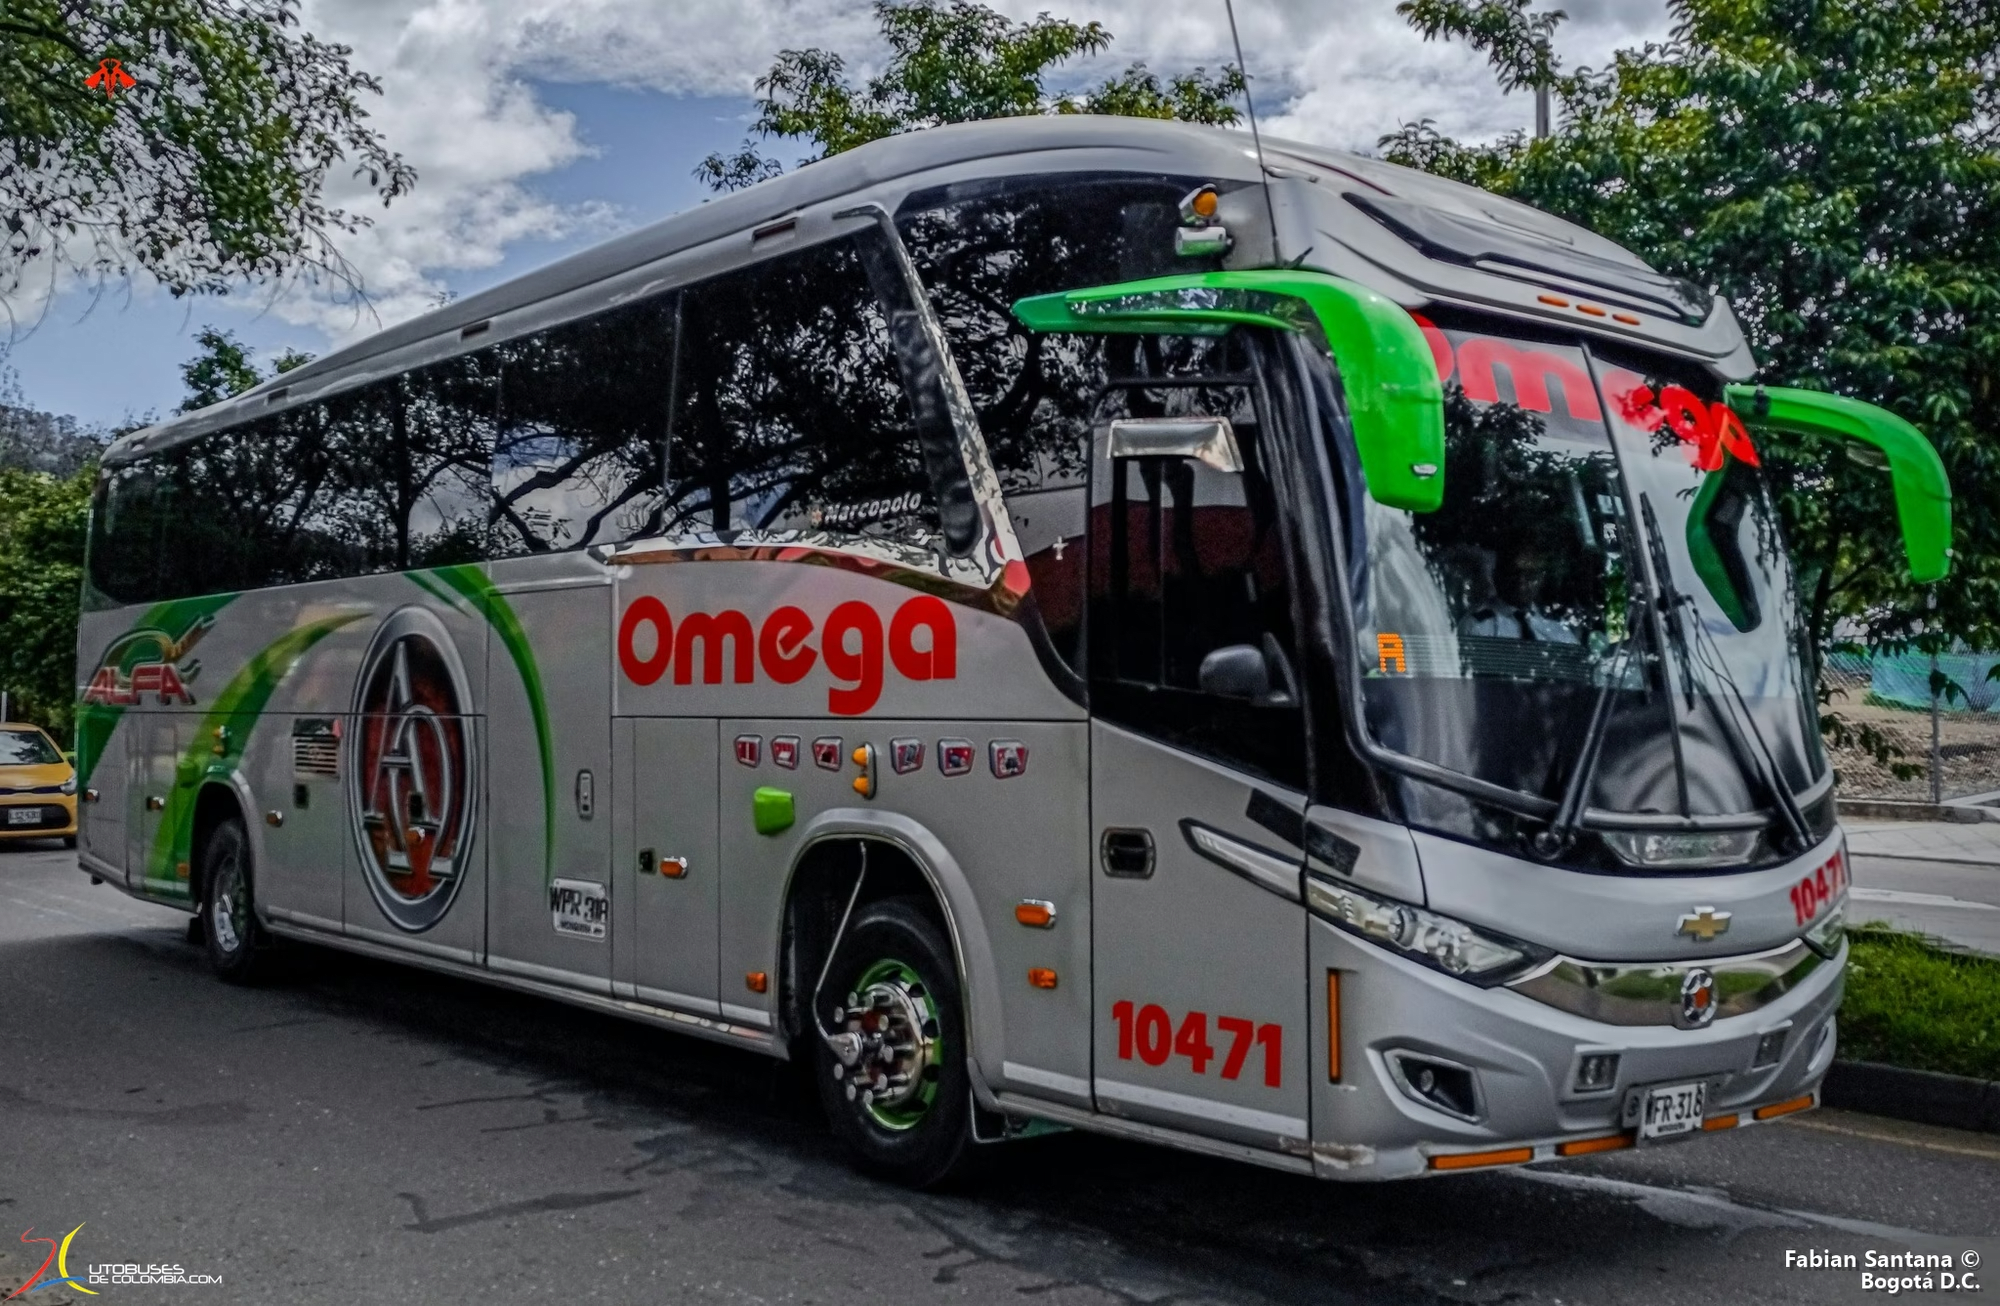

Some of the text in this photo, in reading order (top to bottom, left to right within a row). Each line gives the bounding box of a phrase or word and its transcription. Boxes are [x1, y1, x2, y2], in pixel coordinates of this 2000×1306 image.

[83, 663, 197, 705] ALFA
[617, 595, 958, 716] Omega
[1377, 633, 1406, 672] A
[1789, 848, 1846, 927] 10471
[1112, 999, 1282, 1088] 10471
